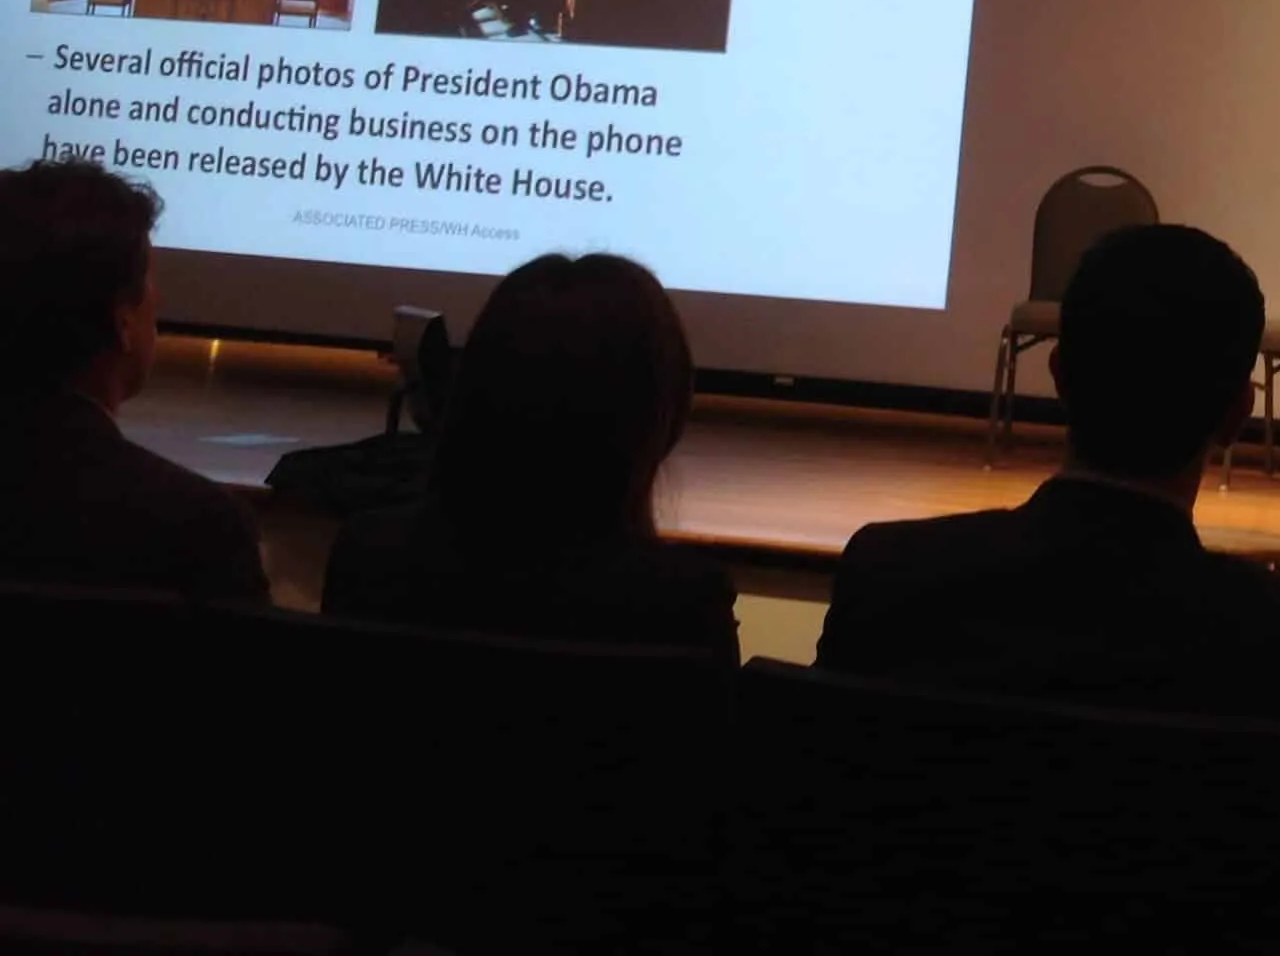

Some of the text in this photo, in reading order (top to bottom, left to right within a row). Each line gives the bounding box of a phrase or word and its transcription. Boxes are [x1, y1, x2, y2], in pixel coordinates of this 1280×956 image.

[53, 43, 659, 108] Several official photos of President Obama
[47, 87, 684, 159] alone and conducting business on the phone
[42, 133, 613, 203] have been released by the White House.
[293, 209, 520, 241] ASSOCIATED PRESS/WH Access
